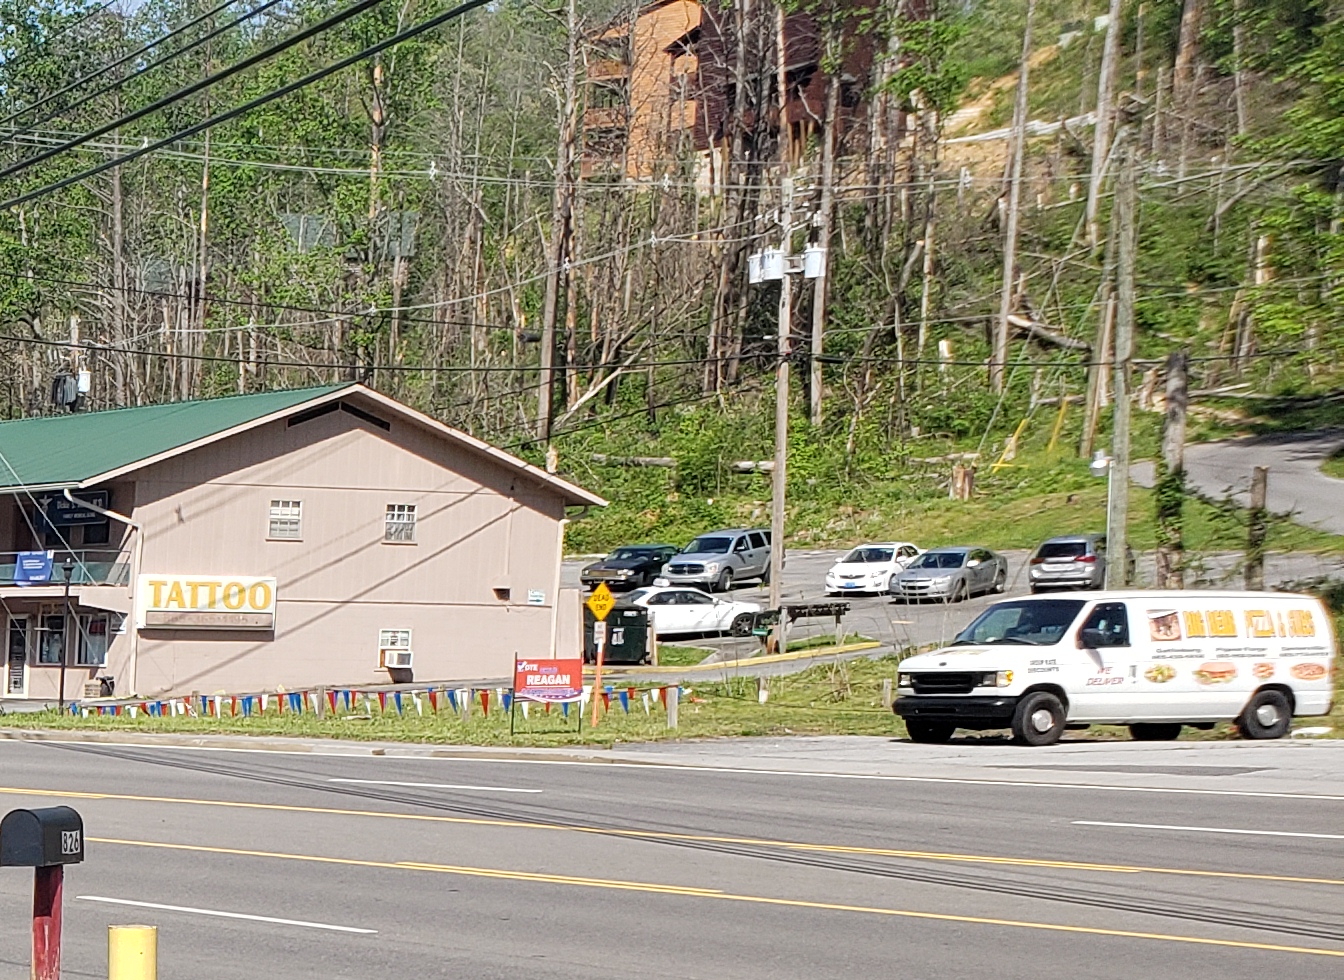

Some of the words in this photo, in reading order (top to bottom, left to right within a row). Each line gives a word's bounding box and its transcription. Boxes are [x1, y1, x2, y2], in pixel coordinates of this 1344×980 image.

[149, 581, 272, 610] TATTOO
[594, 594, 610, 602] DEAD
[526, 674, 571, 685] REAGAN
[63, 832, 79, 852] 826
